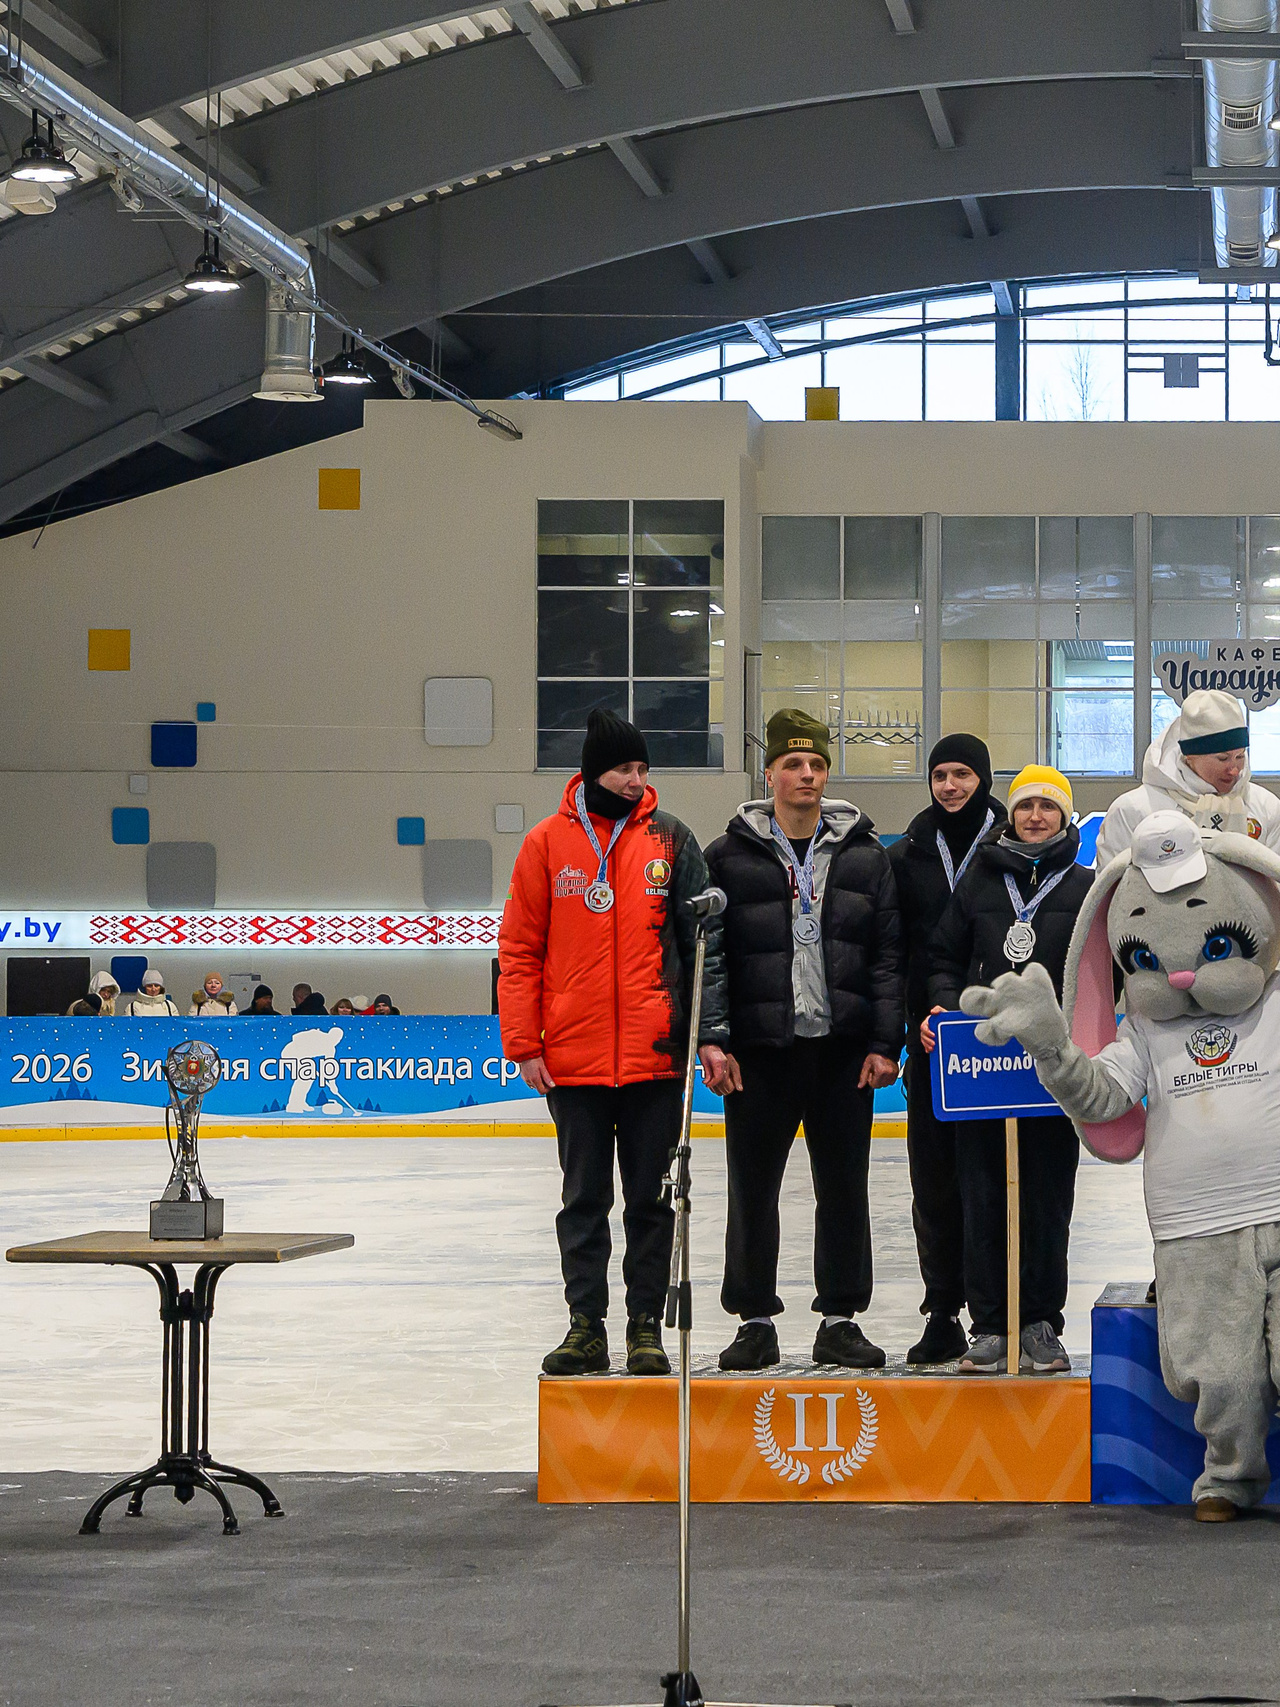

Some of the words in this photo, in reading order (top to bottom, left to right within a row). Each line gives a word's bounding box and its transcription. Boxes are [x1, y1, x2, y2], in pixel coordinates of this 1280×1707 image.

[11, 1053, 93, 1083] 2026
[259, 1057, 473, 1087] спартакиада
[947, 1050, 1037, 1079] Агрохолд
[1173, 1069, 1213, 1087] БЕЛЫЕ
[1215, 1061, 1258, 1078] ТИГРЫ
[786, 1393, 845, 1452] II
